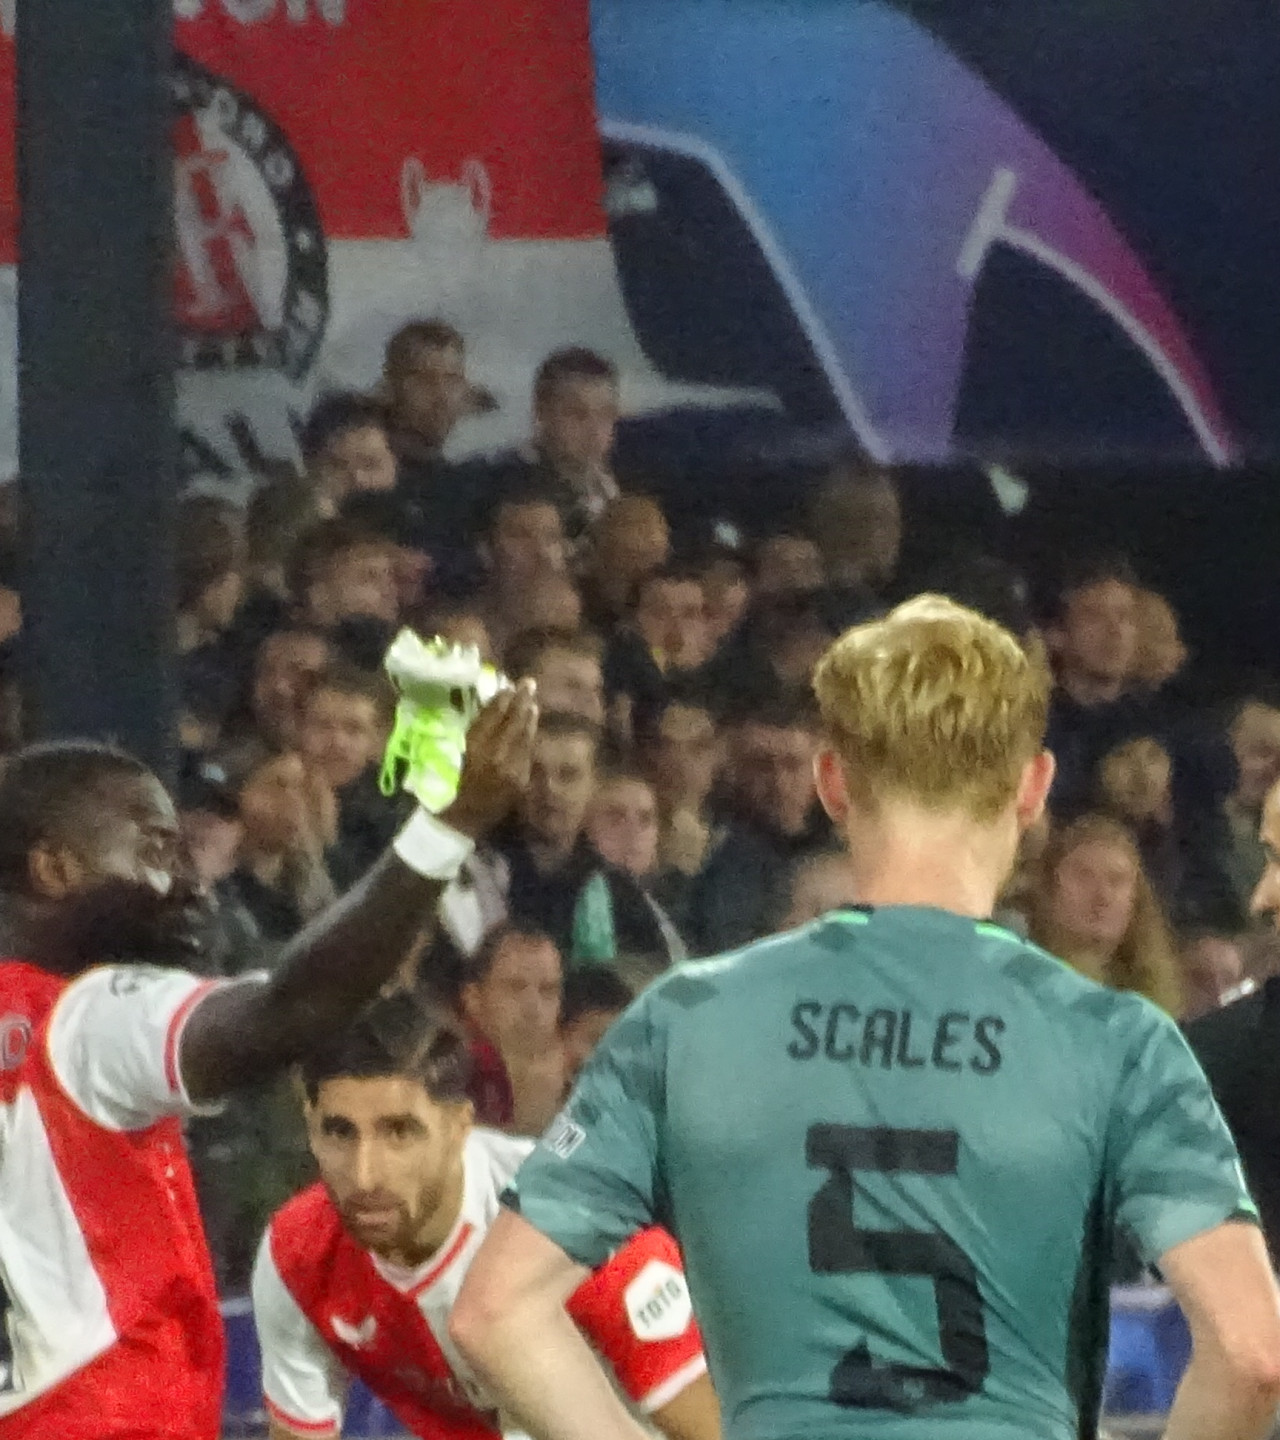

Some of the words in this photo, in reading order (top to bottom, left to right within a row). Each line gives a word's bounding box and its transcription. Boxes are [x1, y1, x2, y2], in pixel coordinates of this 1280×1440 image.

[786, 1000, 1006, 1076] SCALES
[636, 1278, 682, 1329] TOTO
[804, 1122, 991, 1414] 5
